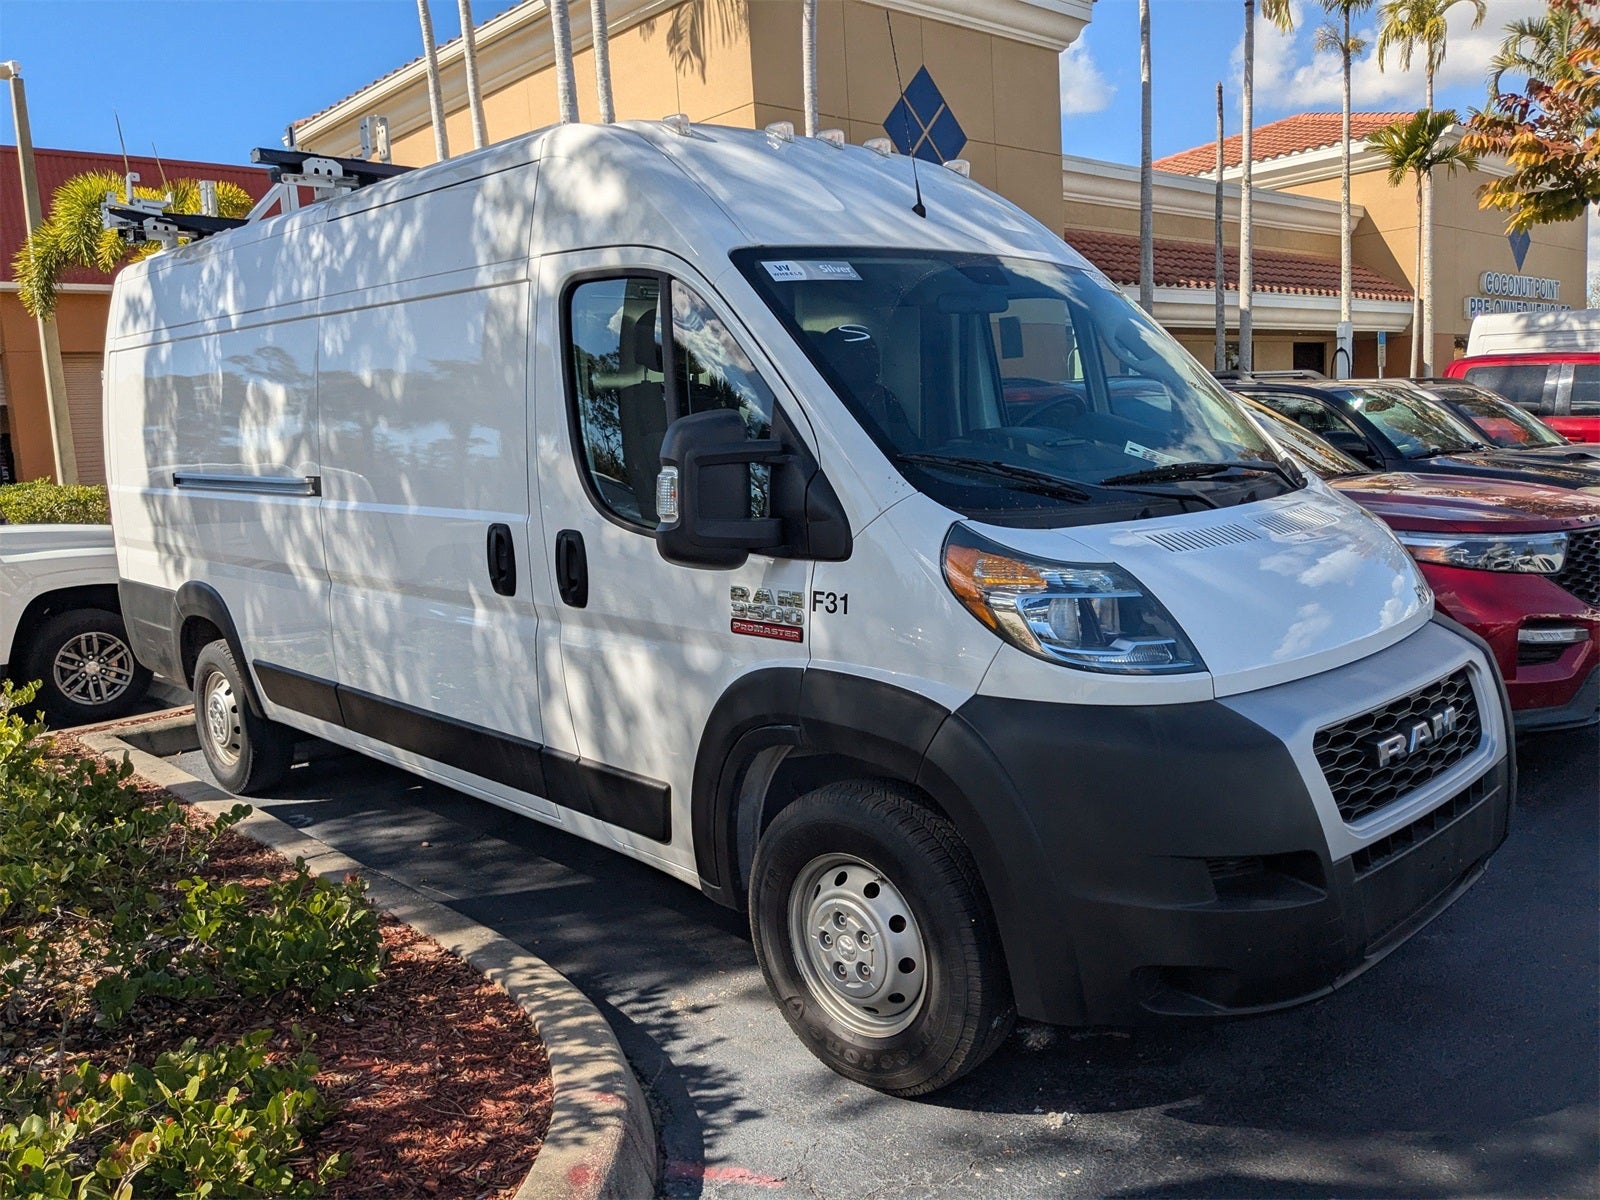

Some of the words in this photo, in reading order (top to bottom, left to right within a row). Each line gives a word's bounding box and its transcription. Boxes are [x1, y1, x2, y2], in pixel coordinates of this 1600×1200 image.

[819, 264, 851, 274] Silver
[1485, 272, 1534, 297] COCONUT
[1535, 279, 1560, 300] POINT
[730, 585, 806, 609] RAM
[812, 590, 849, 615] F31
[1377, 706, 1457, 768] RAM
